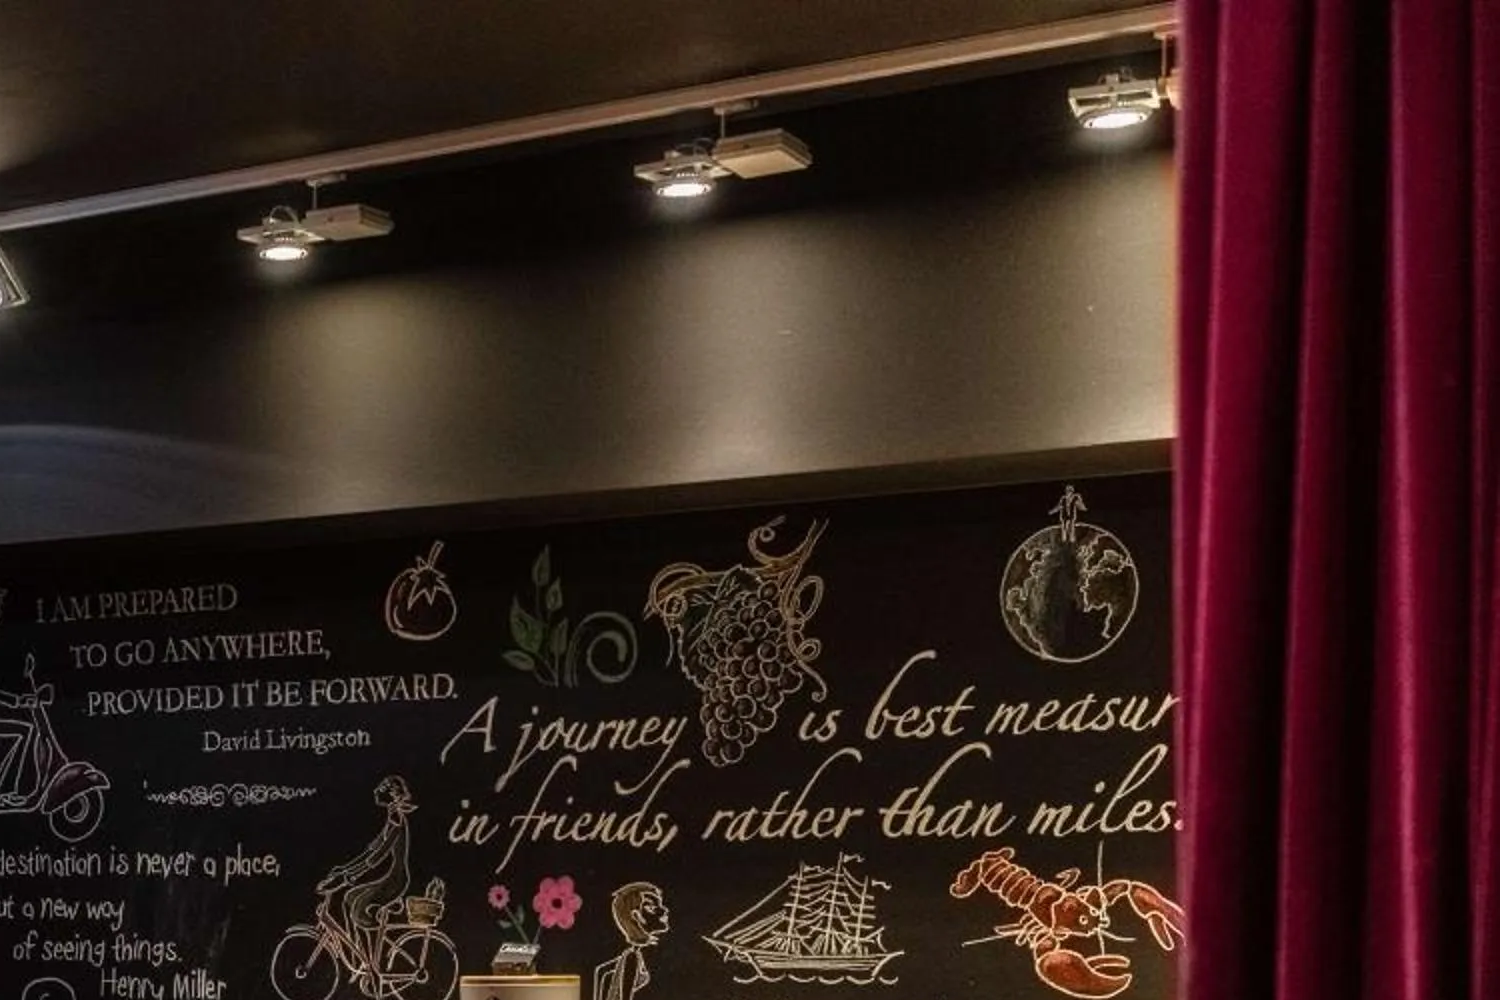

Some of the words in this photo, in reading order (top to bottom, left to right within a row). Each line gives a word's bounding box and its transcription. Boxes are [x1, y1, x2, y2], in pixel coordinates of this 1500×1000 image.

[36, 600, 45, 624] I
[51, 595, 94, 624] AM
[99, 583, 238, 619] PREPARED
[69, 643, 108, 670] TO
[114, 640, 156, 667] GO
[163, 629, 332, 664] ANYWHERE,
[86, 683, 225, 717] PROVIDED
[233, 681, 261, 709] IT
[266, 681, 303, 708] BE
[309, 673, 458, 707] FORWARD.
[202, 730, 261, 753] David
[265, 728, 371, 755] Livingston
[440, 694, 499, 765] A
[494, 706, 688, 796] journey
[799, 700, 840, 743] is
[863, 650, 976, 739] best
[984, 692, 1181, 735] measur
[449, 798, 499, 846] in
[494, 755, 690, 873] friends,
[701, 748, 864, 841] rather
[878, 742, 1014, 839] than
[1027, 743, 1184, 837] miles.
[109, 848, 130, 875] is
[135, 853, 196, 877] never
[203, 857, 216, 877] a
[224, 842, 281, 886] place,
[22, 903, 36, 918] a
[41, 898, 79, 919] new
[87, 899, 126, 930] way
[13, 931, 40, 961] of
[43, 936, 105, 967] seeing
[112, 937, 183, 967] things.
